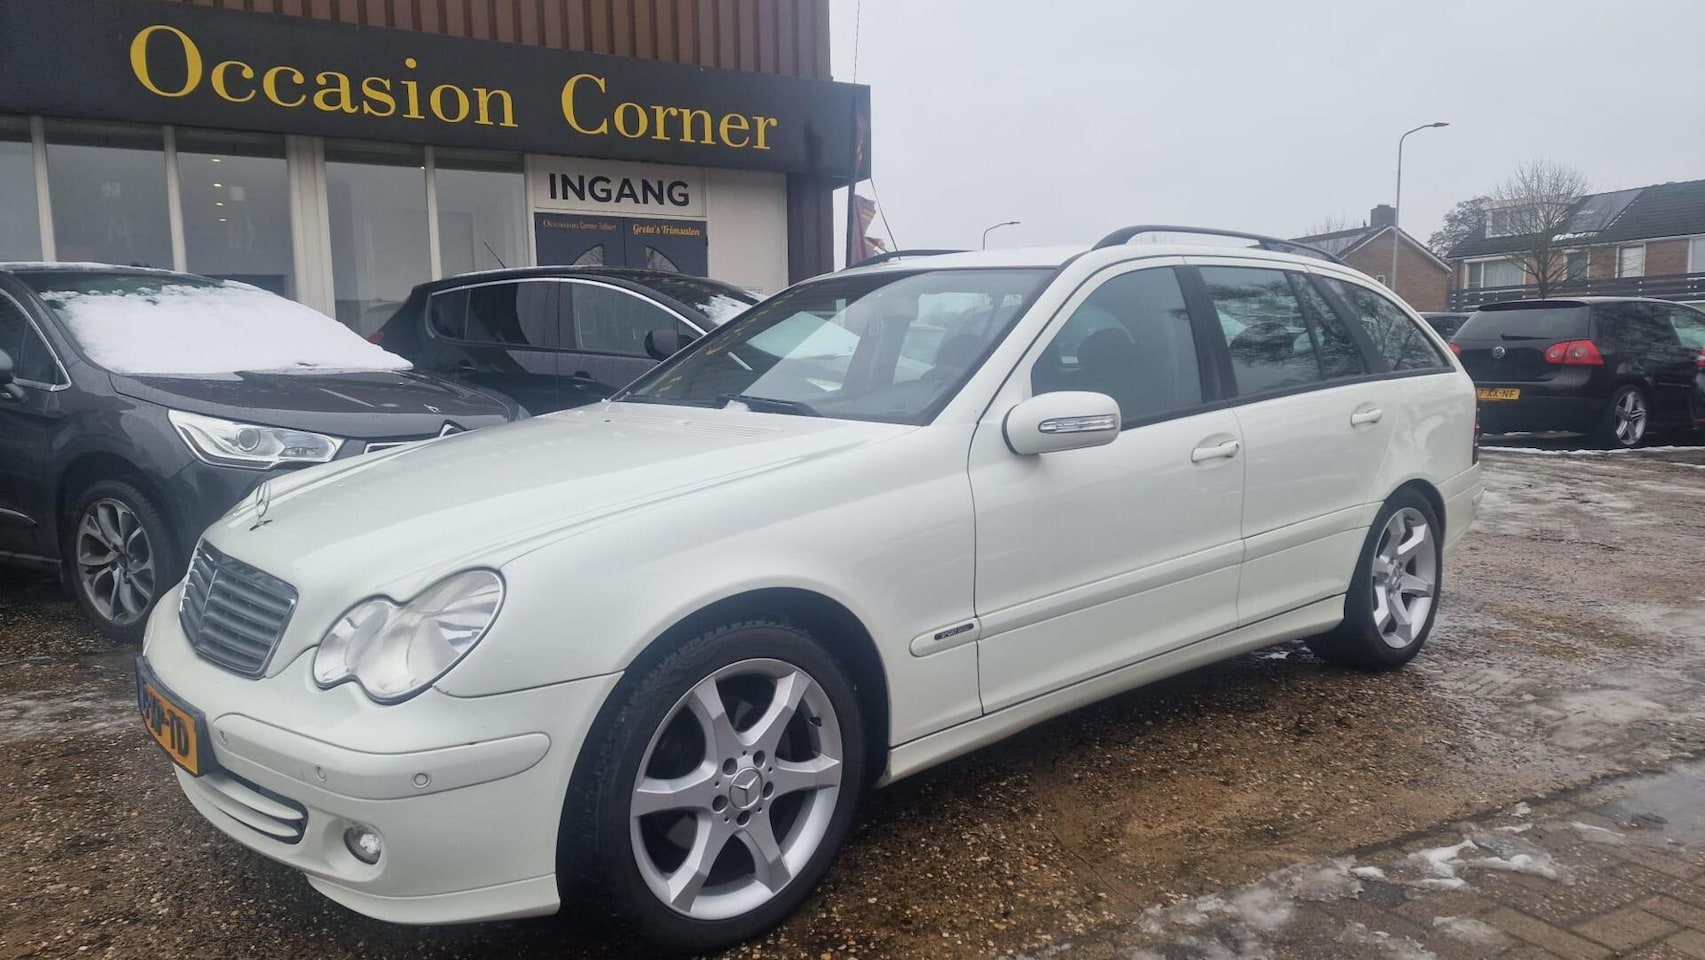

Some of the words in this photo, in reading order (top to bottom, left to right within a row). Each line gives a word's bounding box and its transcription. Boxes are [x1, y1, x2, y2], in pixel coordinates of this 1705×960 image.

[129, 25, 517, 128] Occasion
[561, 74, 778, 151] Corner
[549, 173, 690, 207] INGANG
[632, 223, 660, 236] Greta's
